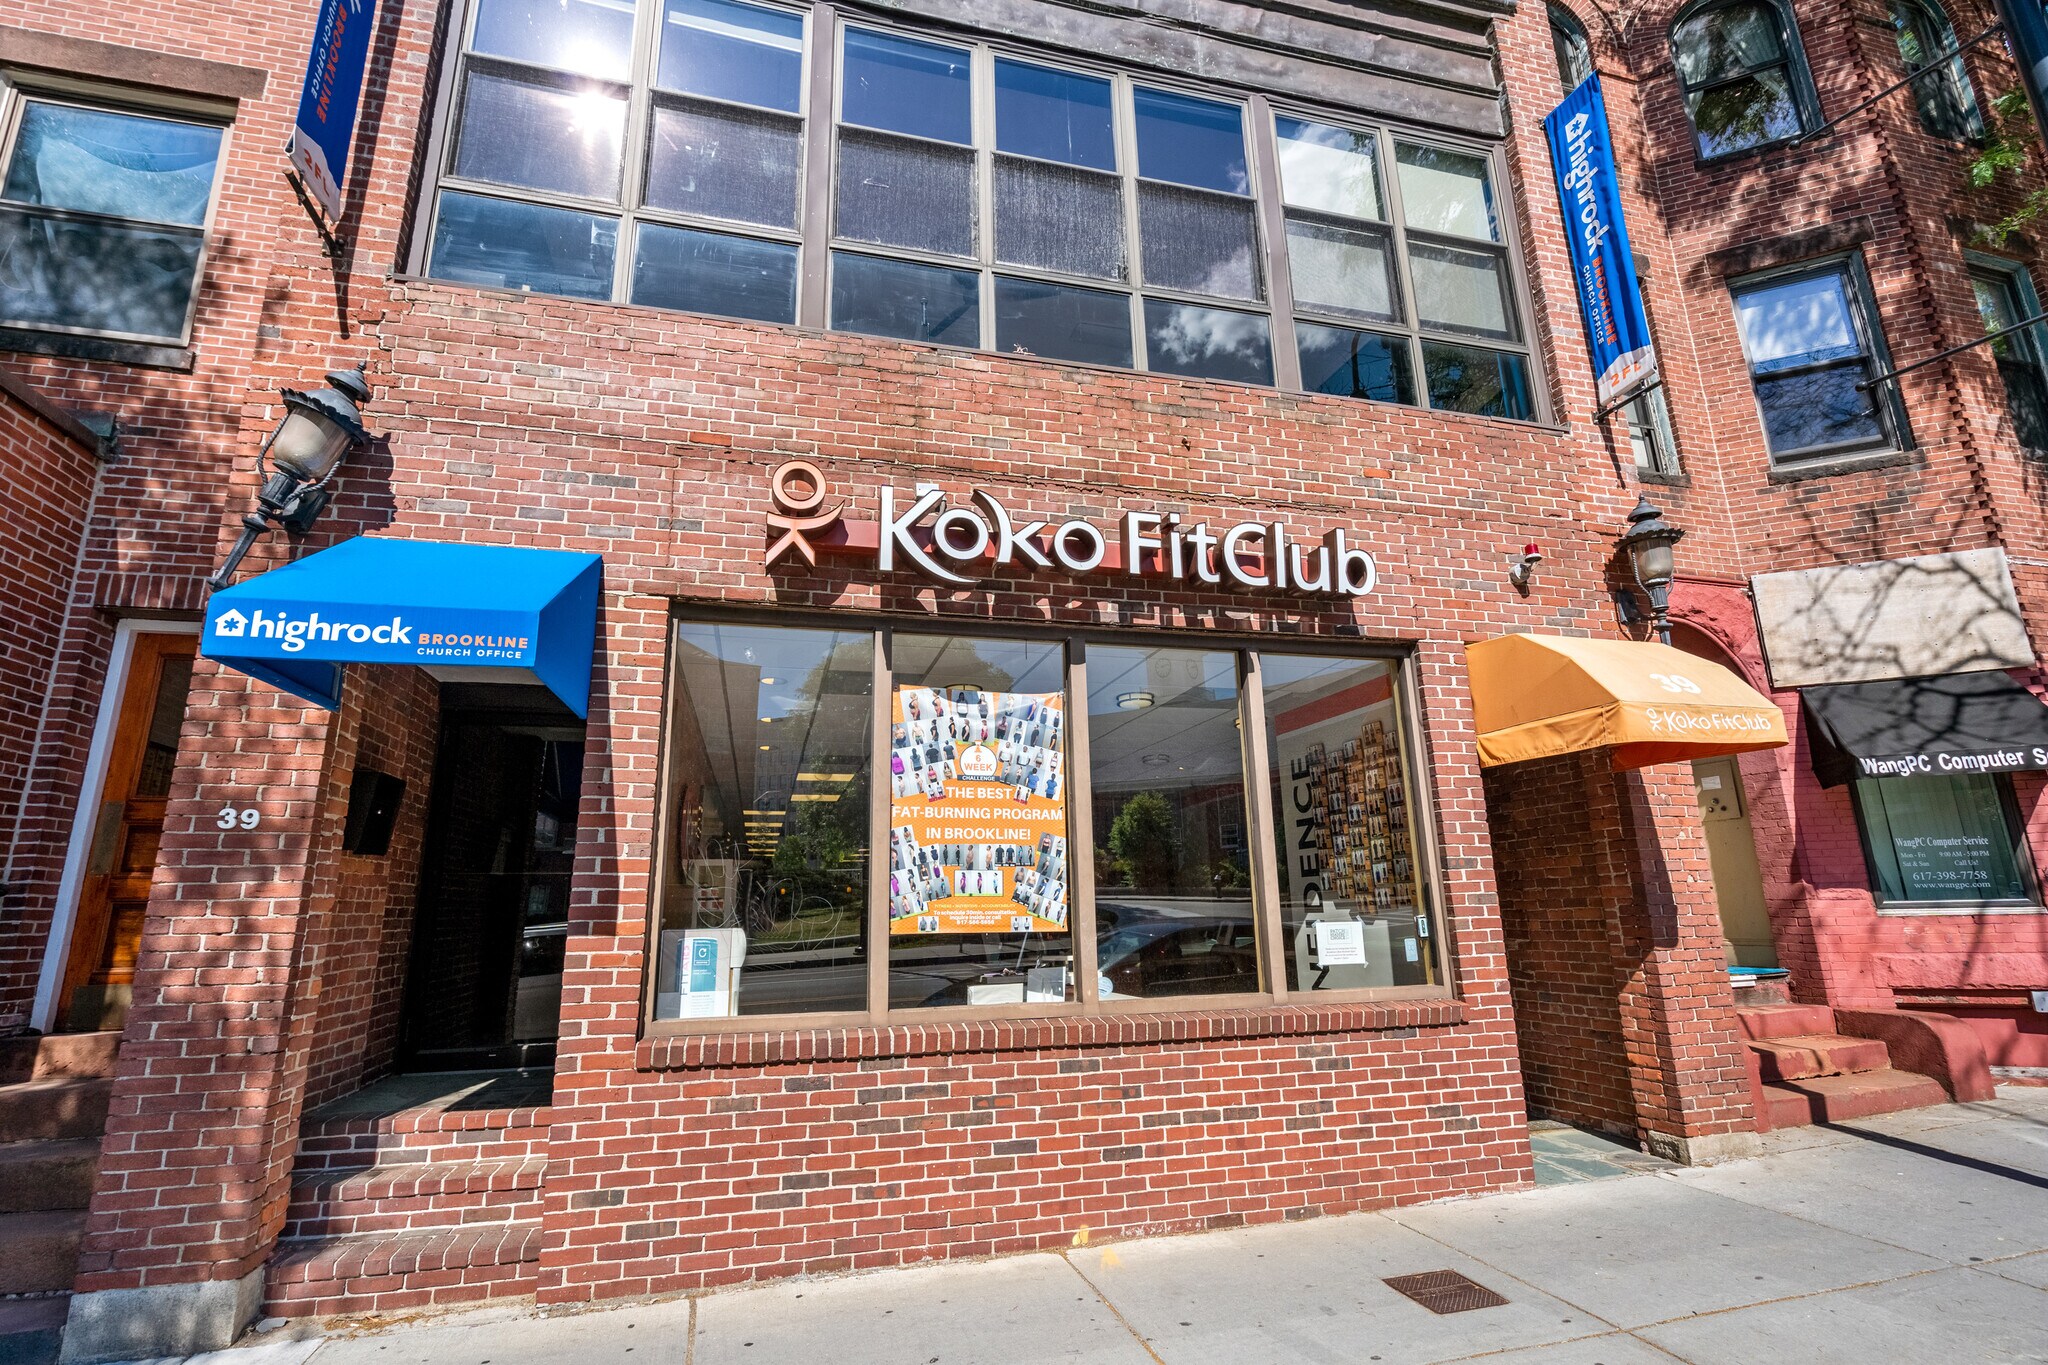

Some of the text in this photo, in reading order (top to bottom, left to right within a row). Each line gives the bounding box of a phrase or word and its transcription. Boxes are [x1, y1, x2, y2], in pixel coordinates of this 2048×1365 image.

[310, 0, 339, 99] HURCH OFFICE
[317, 3, 348, 124] BROOKLINE
[1563, 129, 1610, 257] highrock
[1582, 265, 1605, 345] CHURCH OFFICE
[1592, 255, 1618, 346] BROOKLINE
[878, 484, 1378, 598] Koko FitClub
[249, 608, 414, 652] highrock
[418, 633, 529, 650] BROOKLINE
[416, 647, 523, 660] CHURCH OFFICE
[1649, 673, 1702, 695] 39
[1663, 709, 1772, 734] Koko FitClub
[964, 763, 993, 772] WEEK
[975, 754, 982, 762] 6
[1860, 747, 2048, 777] WangPC Computer S
[946, 787, 1013, 800] THE BEST
[216, 807, 261, 831] 39
[892, 806, 1063, 821] FAT-BURNING PROGRAM
[925, 826, 1031, 841] IN BROOKLINE!
[1895, 835, 1989, 849] WangPC Computer Service
[1912, 870, 1988, 881] 617-398-7758
[1913, 881, 1991, 890] www.wangpc.com
